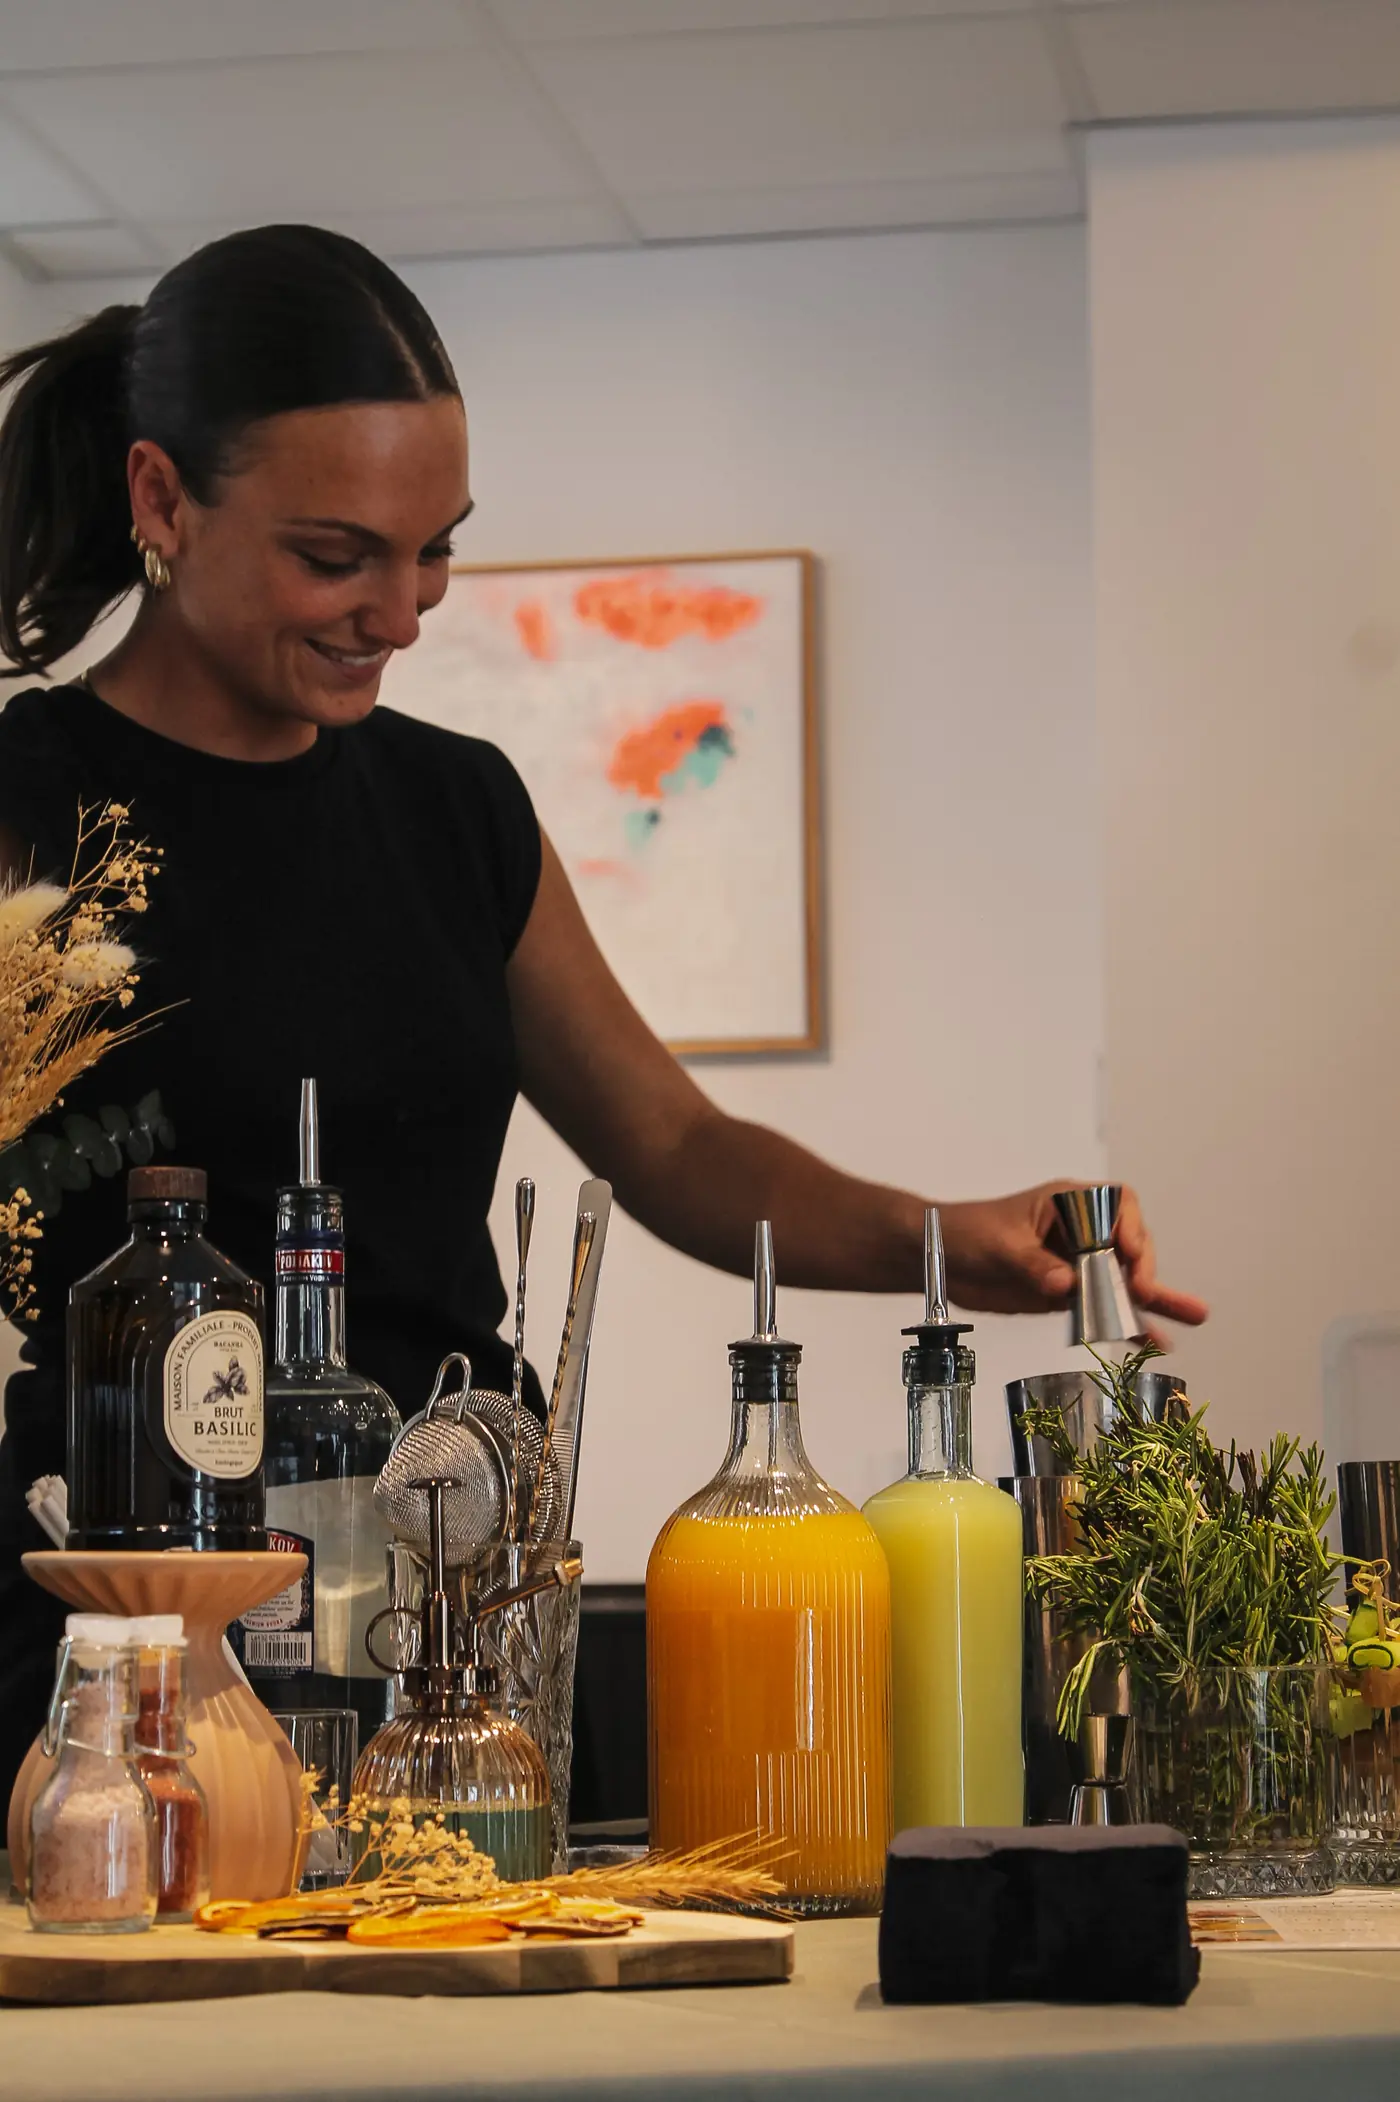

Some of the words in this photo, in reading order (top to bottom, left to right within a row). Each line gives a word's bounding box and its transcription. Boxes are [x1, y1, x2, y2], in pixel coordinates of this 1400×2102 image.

[177, 1320, 225, 1360] FAMILIALE
[174, 1362, 183, 1411] MAISON
[214, 1407, 244, 1418] BRUT
[194, 1421, 257, 1437] BASILIC
[269, 1536, 295, 1553] KOV
